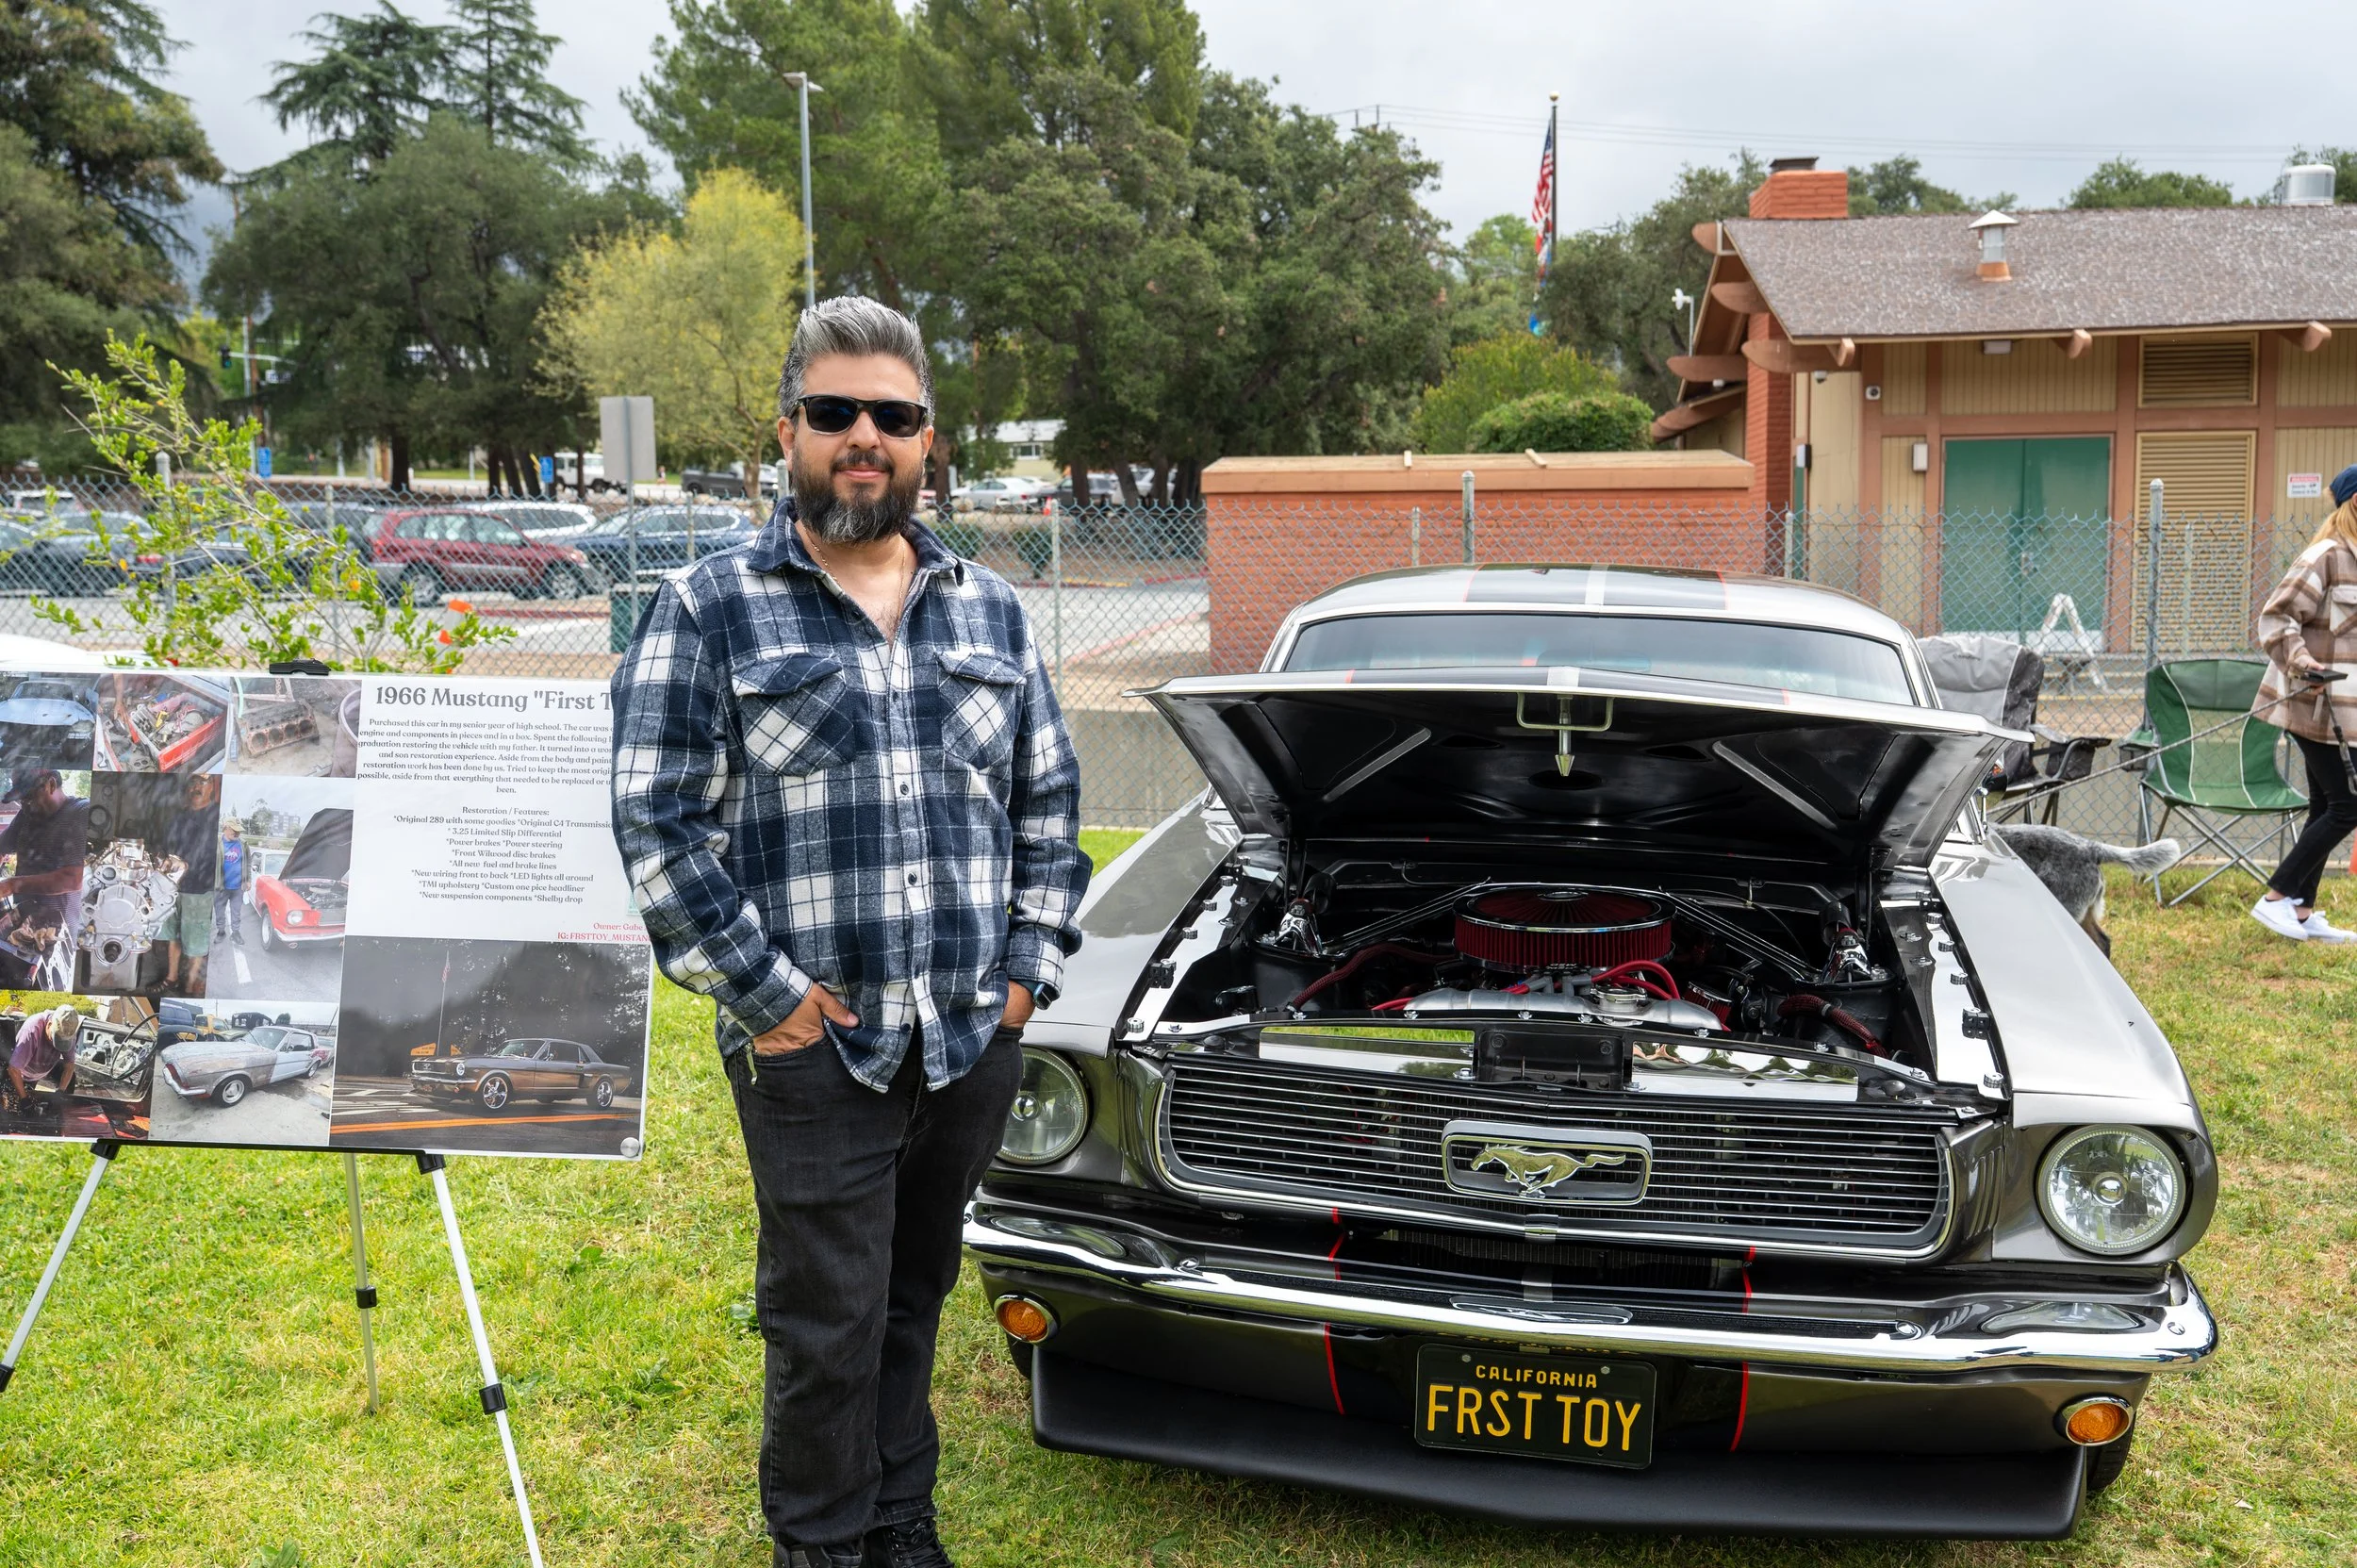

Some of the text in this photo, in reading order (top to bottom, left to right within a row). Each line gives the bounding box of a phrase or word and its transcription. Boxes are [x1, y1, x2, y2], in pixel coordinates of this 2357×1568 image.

[376, 686, 426, 705] 1966
[431, 687, 528, 713] Mustang
[534, 690, 595, 710] "First
[369, 718, 410, 727] Purchased
[411, 719, 425, 728] this
[440, 719, 448, 728] in
[450, 721, 461, 730] my
[463, 720, 486, 729] senior
[517, 722, 533, 731] high
[535, 722, 562, 731] school.
[564, 723, 578, 732] The
[403, 731, 450, 739] components
[534, 734, 555, 742] Spent
[570, 734, 607, 744] following
[403, 741, 437, 750] restoring
[438, 741, 451, 750] the
[512, 743, 537, 751] father.
[574, 745, 589, 753] into
[454, 752, 497, 761] experience.
[555, 755, 574, 765] body
[407, 762, 428, 770] work
[429, 762, 442, 770] has
[444, 763, 461, 771] been
[463, 763, 482, 771] done
[483, 764, 493, 772] by
[537, 766, 556, 774] keep
[592, 767, 612, 776] origi
[357, 772, 390, 781] possible,
[392, 772, 413, 781] aside
[414, 772, 433, 781] from
[453, 774, 494, 783] everything
[551, 776, 560, 784] be
[562, 777, 595, 786] replaced
[462, 806, 507, 815] Restoration
[429, 816, 444, 824] 289
[486, 817, 516, 827] goodies
[470, 828, 500, 836] Limited
[501, 829, 516, 837] Slip
[517, 830, 562, 838] Differential
[531, 841, 563, 850] steering
[478, 850, 511, 858] Wilwood
[512, 850, 529, 859] disc
[538, 862, 557, 870] lines
[433, 870, 458, 879] wiring
[459, 870, 479, 879] front
[489, 871, 509, 880] back
[531, 872, 553, 882] lights
[554, 873, 565, 882] all
[438, 881, 480, 890] upholstery
[548, 883, 585, 893] headliner
[440, 892, 484, 901] suspension
[485, 893, 533, 902] components
[564, 895, 584, 904] drop
[1475, 1365, 1597, 1389] CALIFORNIA
[1426, 1383, 1641, 1451] FRST TOY
